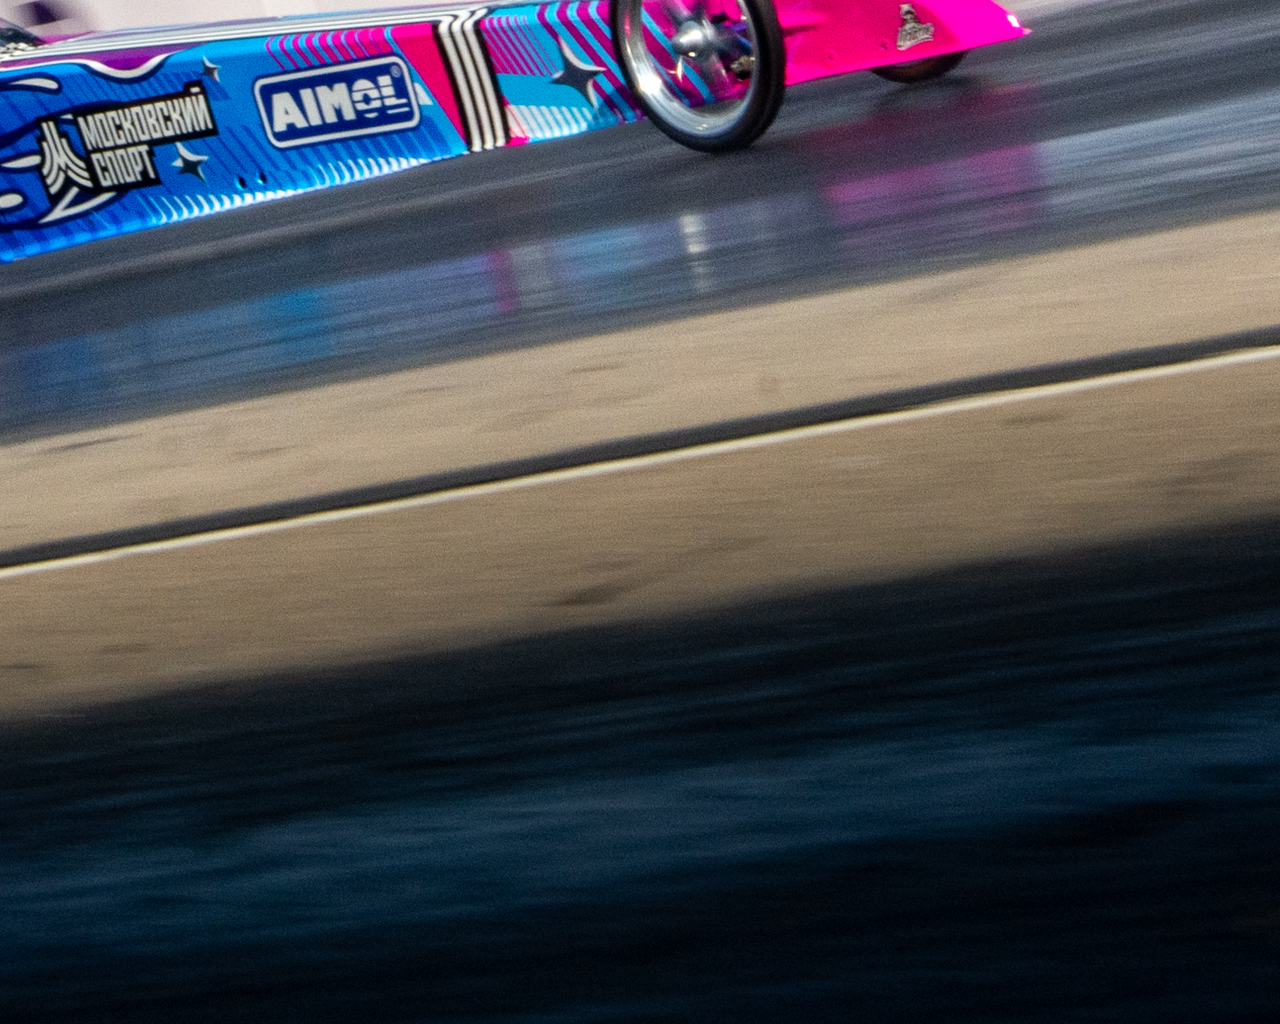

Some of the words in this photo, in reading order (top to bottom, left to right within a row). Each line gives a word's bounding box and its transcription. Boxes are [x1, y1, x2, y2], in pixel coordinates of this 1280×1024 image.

[77, 87, 214, 151] МОСКОВСКИЙ
[271, 75, 411, 133] AIMOL
[90, 144, 156, 187] СПОРТ
